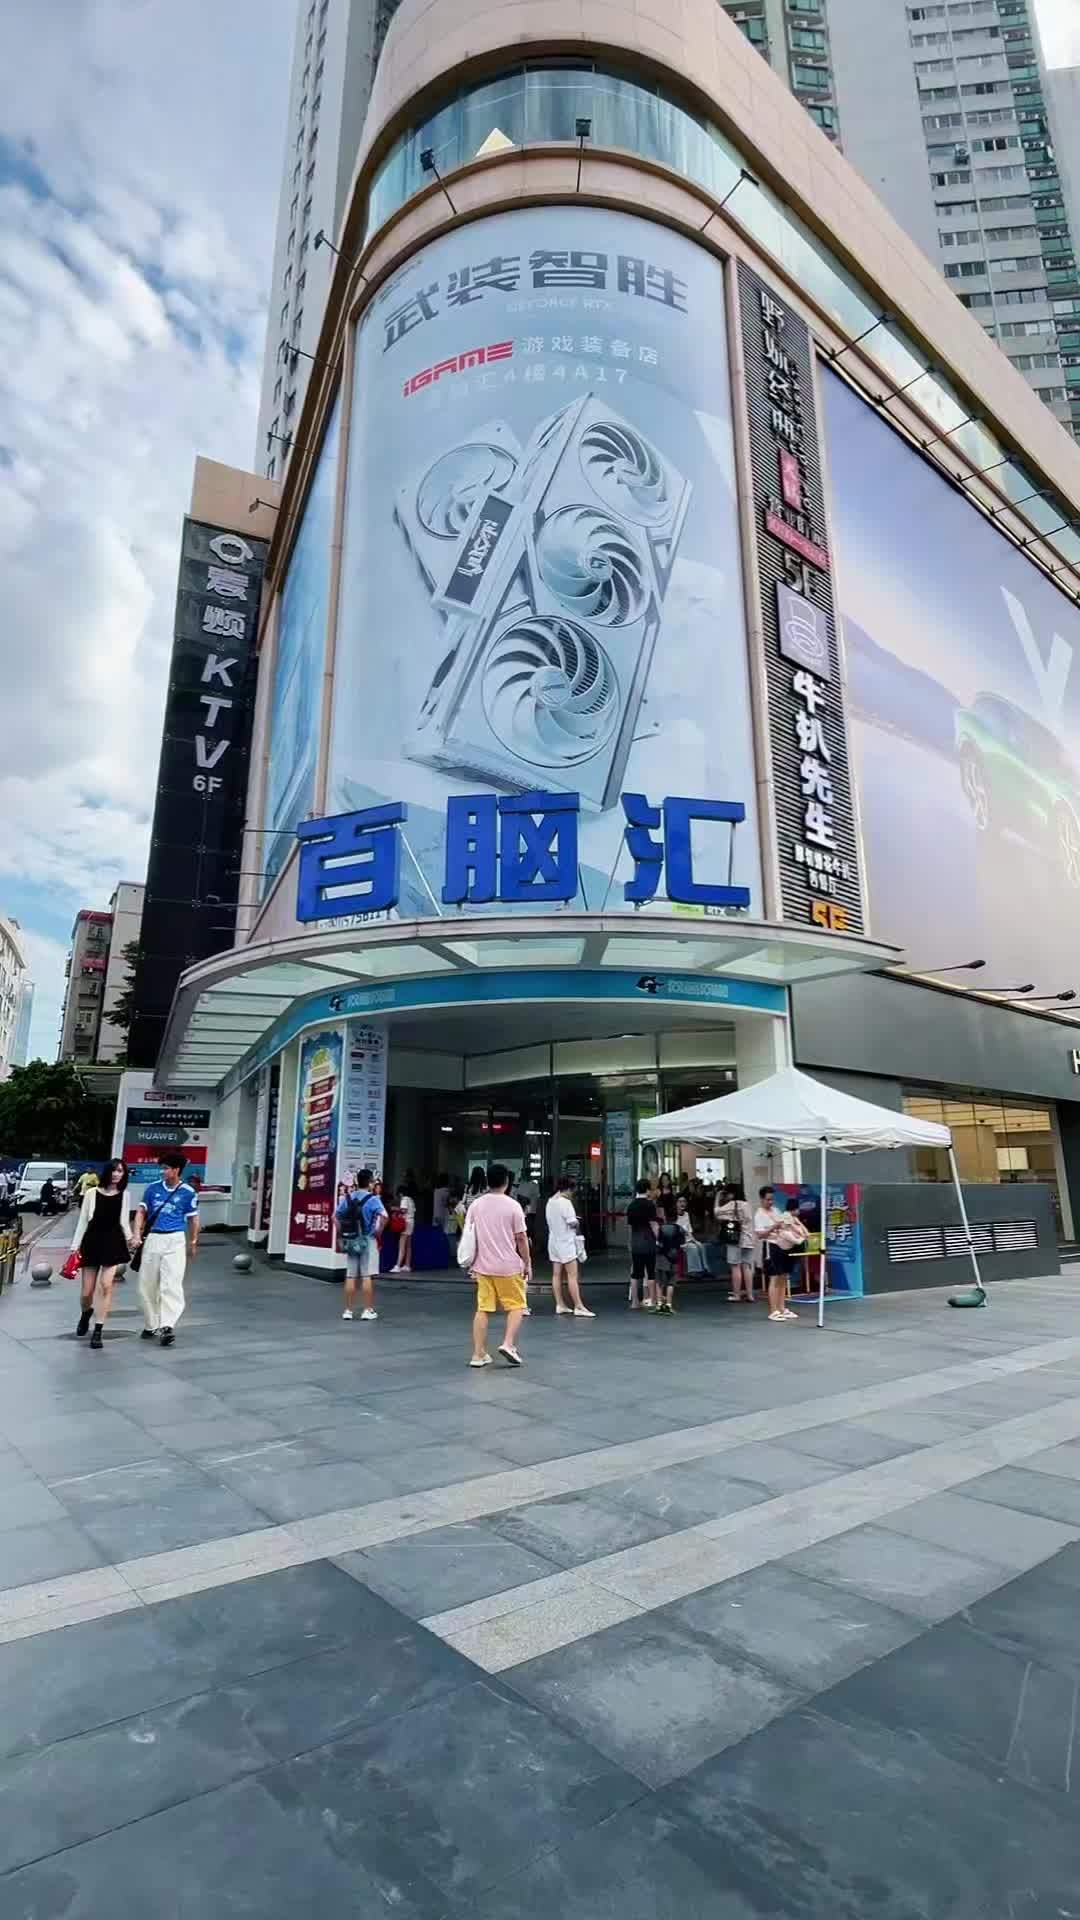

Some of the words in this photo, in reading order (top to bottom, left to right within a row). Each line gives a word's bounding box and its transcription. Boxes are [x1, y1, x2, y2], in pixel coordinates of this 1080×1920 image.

[383, 249, 689, 353] 武装智胜
[520, 335, 658, 365] 游戏装备店
[192, 775, 223, 793] 6F
[793, 670, 837, 850] 牛扒先生
[295, 789, 751, 923] 百脑汇
[137, 1132, 177, 1141] HUAWEI
